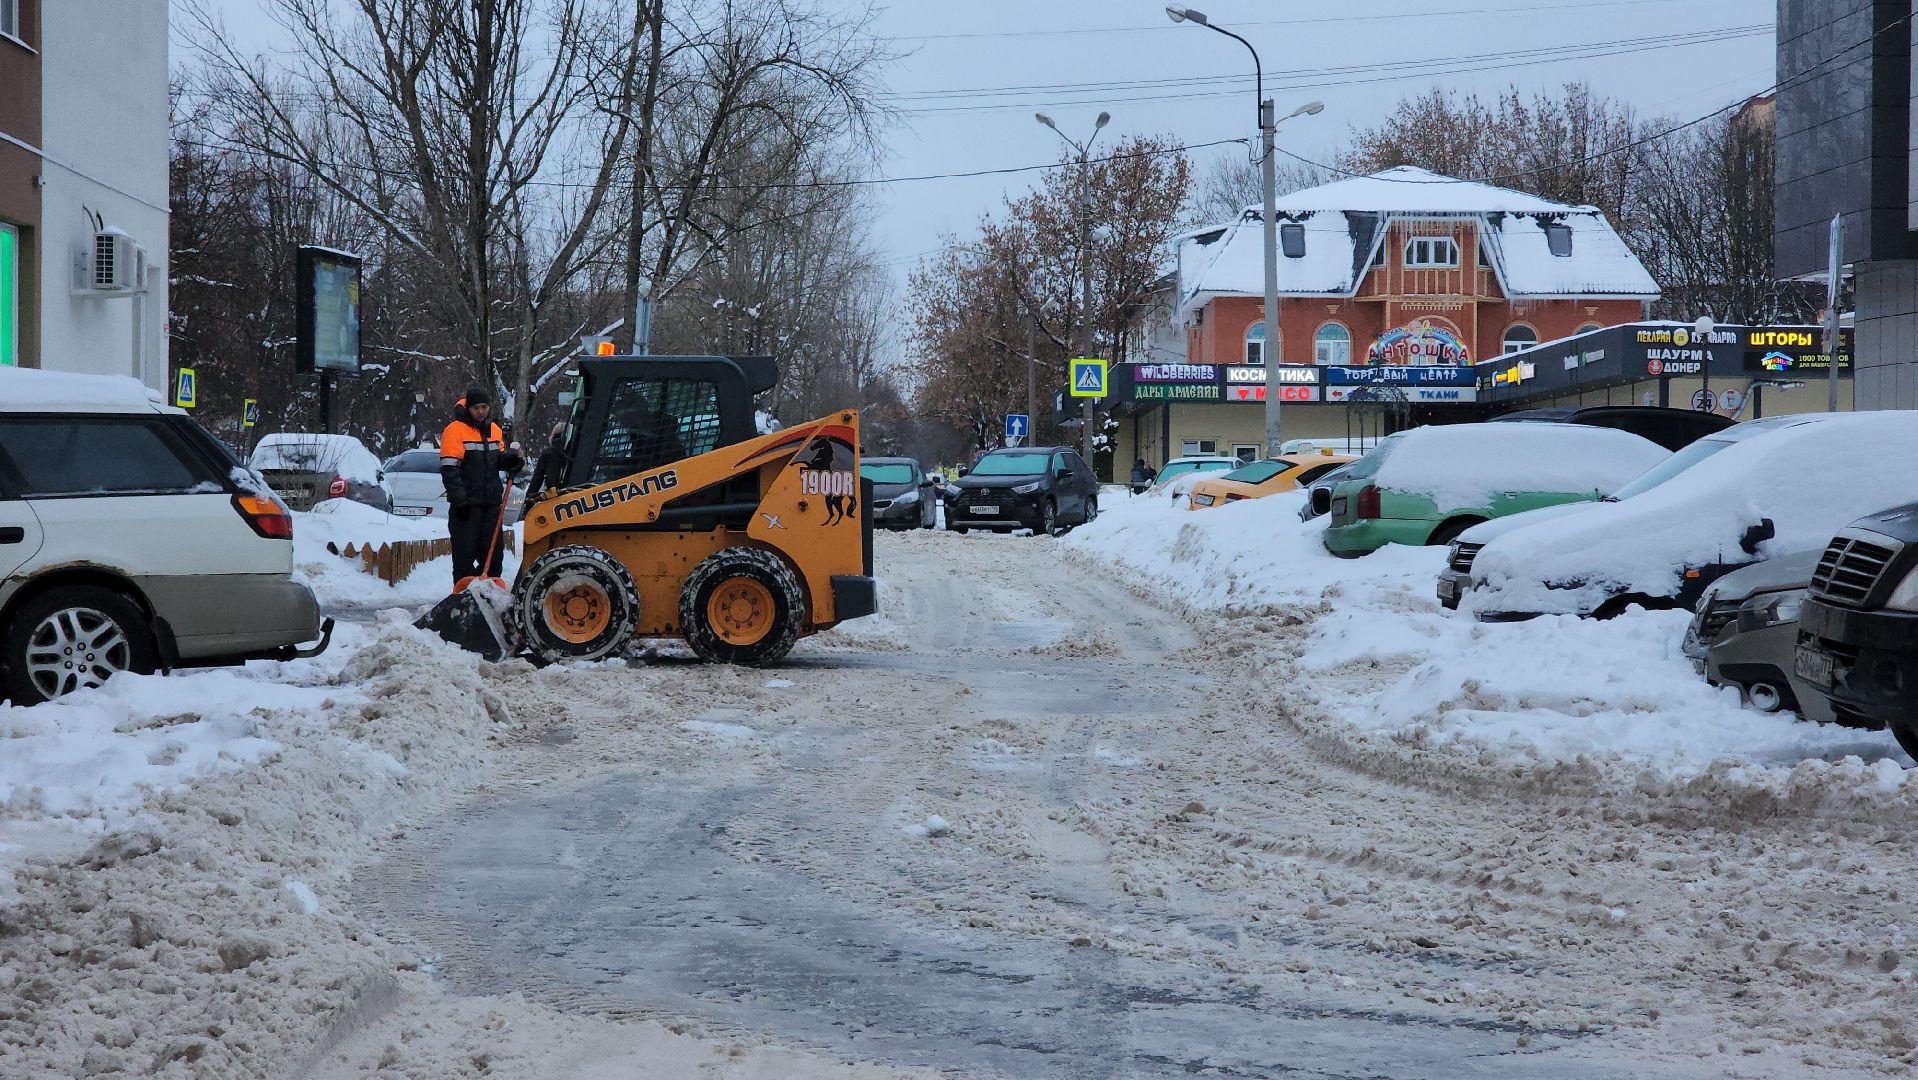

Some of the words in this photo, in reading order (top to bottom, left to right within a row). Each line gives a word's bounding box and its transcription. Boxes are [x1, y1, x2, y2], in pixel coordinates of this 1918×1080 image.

[1750, 332, 1812, 346] ШТОРЫ
[1368, 343, 1469, 362] АНТОШКА
[1817, 354, 1849, 362] ТОВОВ
[1141, 365, 1215, 380] WILDBERRIES
[1420, 367, 1458, 381] ЦЕНТР
[1663, 362, 1701, 373] ДОНЕР
[1230, 369, 1315, 382] КОСМТИКА
[1135, 386, 1164, 399] ДАРЫ
[1168, 386, 1220, 399] АРМЕНИЯ
[1255, 387, 1311, 400] МСО
[1419, 390, 1459, 400] ТКАНИ
[801, 470, 856, 497] 1900R
[553, 469, 678, 522] MUSTANG
